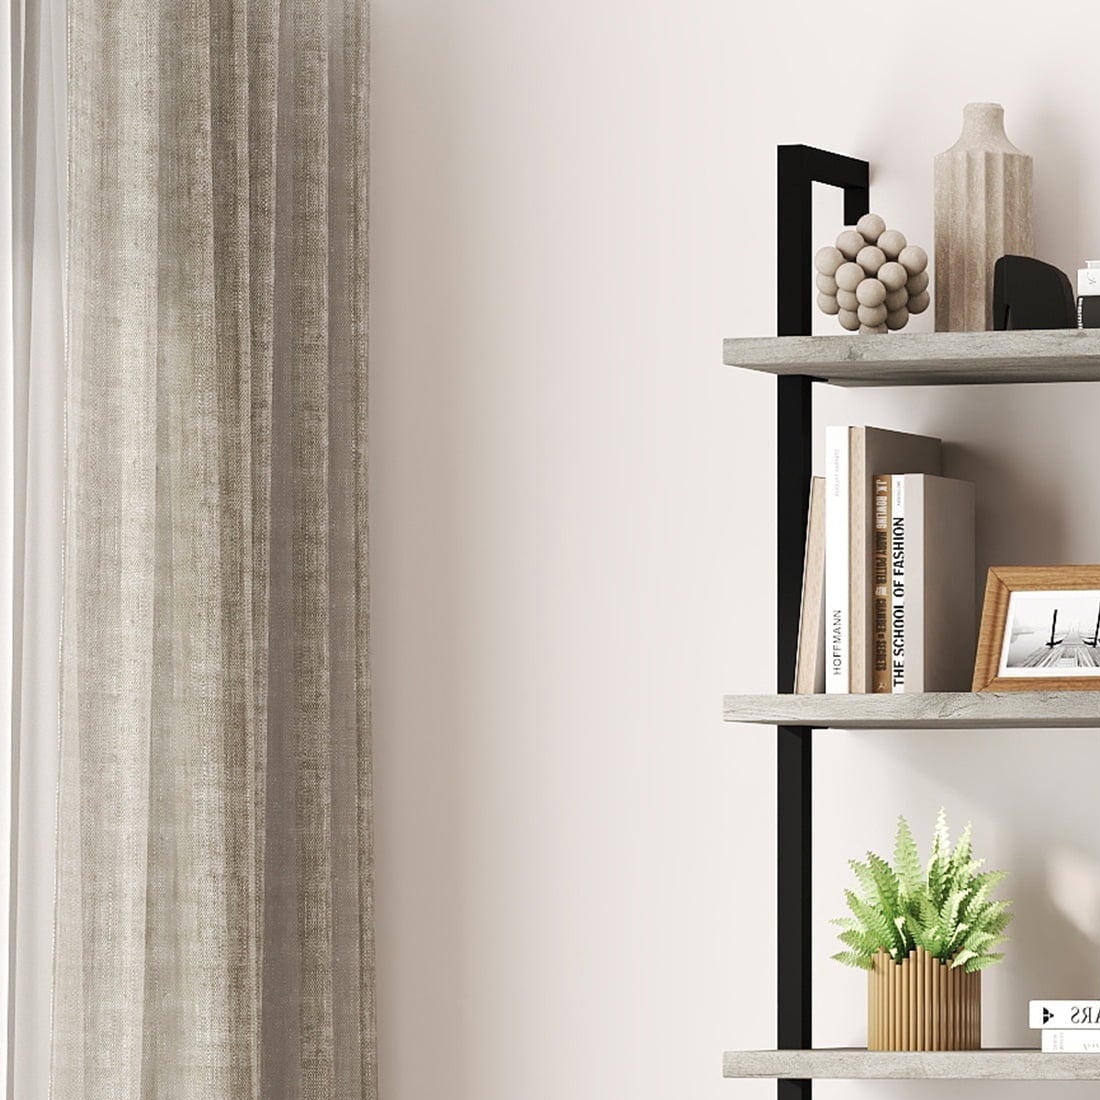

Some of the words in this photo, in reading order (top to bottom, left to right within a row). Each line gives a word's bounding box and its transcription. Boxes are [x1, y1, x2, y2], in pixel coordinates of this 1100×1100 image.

[875, 495, 888, 529] ROWLING
[892, 517, 905, 577] FASHION
[892, 580, 905, 598] OF
[832, 609, 843, 676] HOFFMANN
[892, 601, 905, 657] SCHOOL
[892, 660, 905, 688] THE
